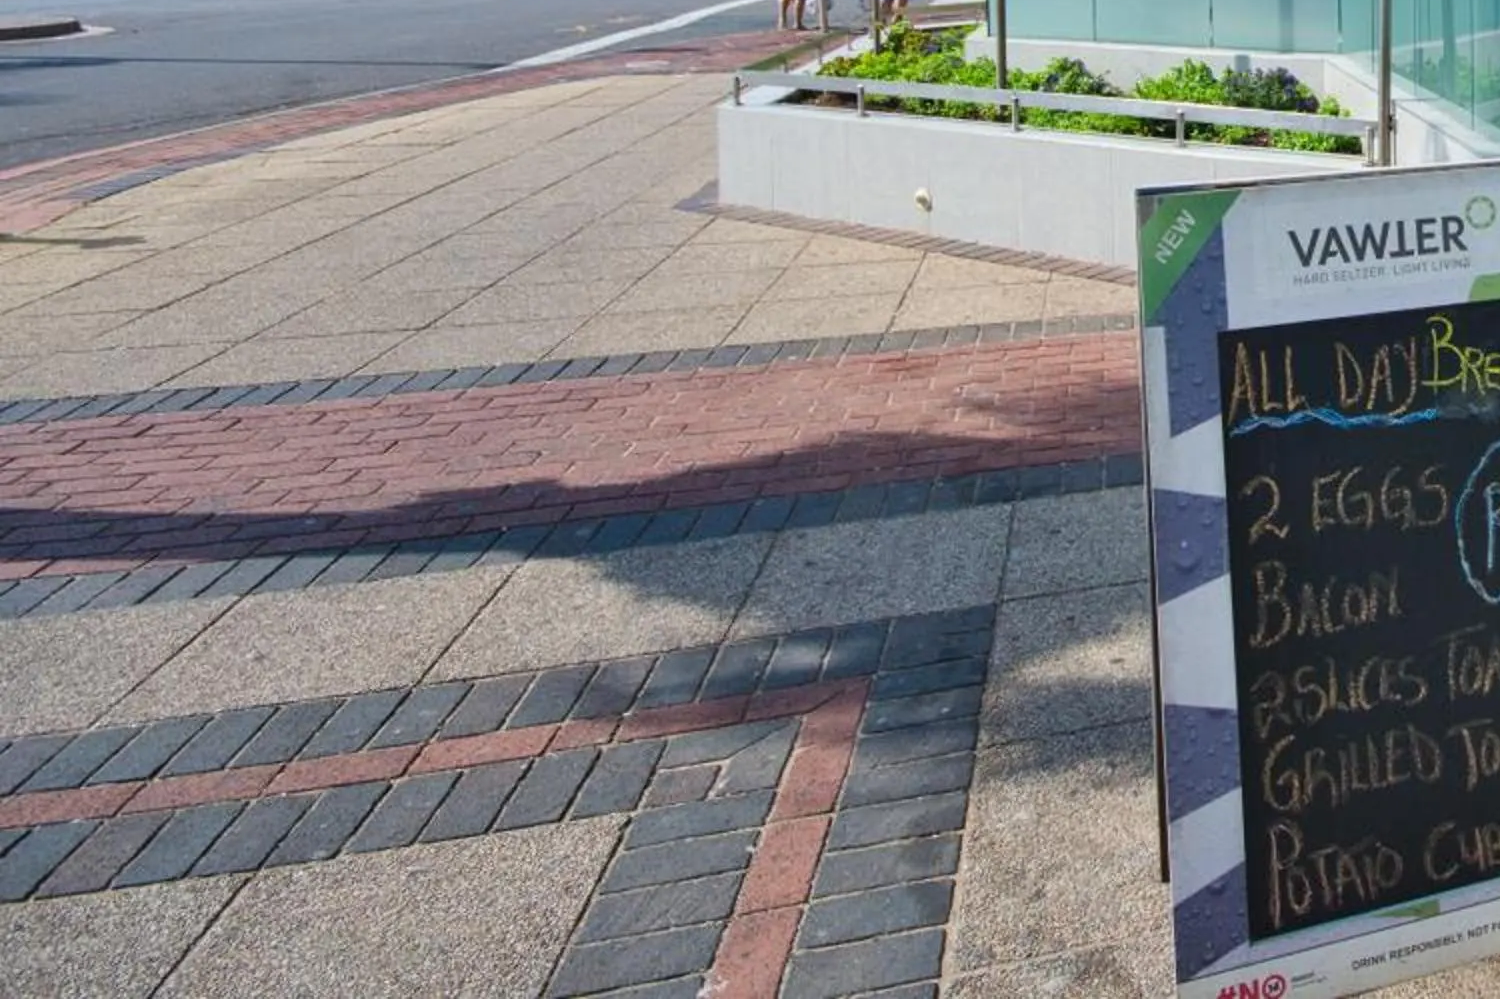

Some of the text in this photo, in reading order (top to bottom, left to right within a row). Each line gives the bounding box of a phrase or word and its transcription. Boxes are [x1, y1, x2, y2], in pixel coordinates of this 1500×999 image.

[1155, 209, 1196, 264] NEW
[1293, 271, 1329, 286] HARD
[1229, 341, 1311, 425] ALL
[1335, 336, 1417, 417] DAY
[1241, 465, 1449, 544] 2 EGGS
[1351, 955, 1386, 970] DRINK
[1467, 925, 1489, 940] NOT
